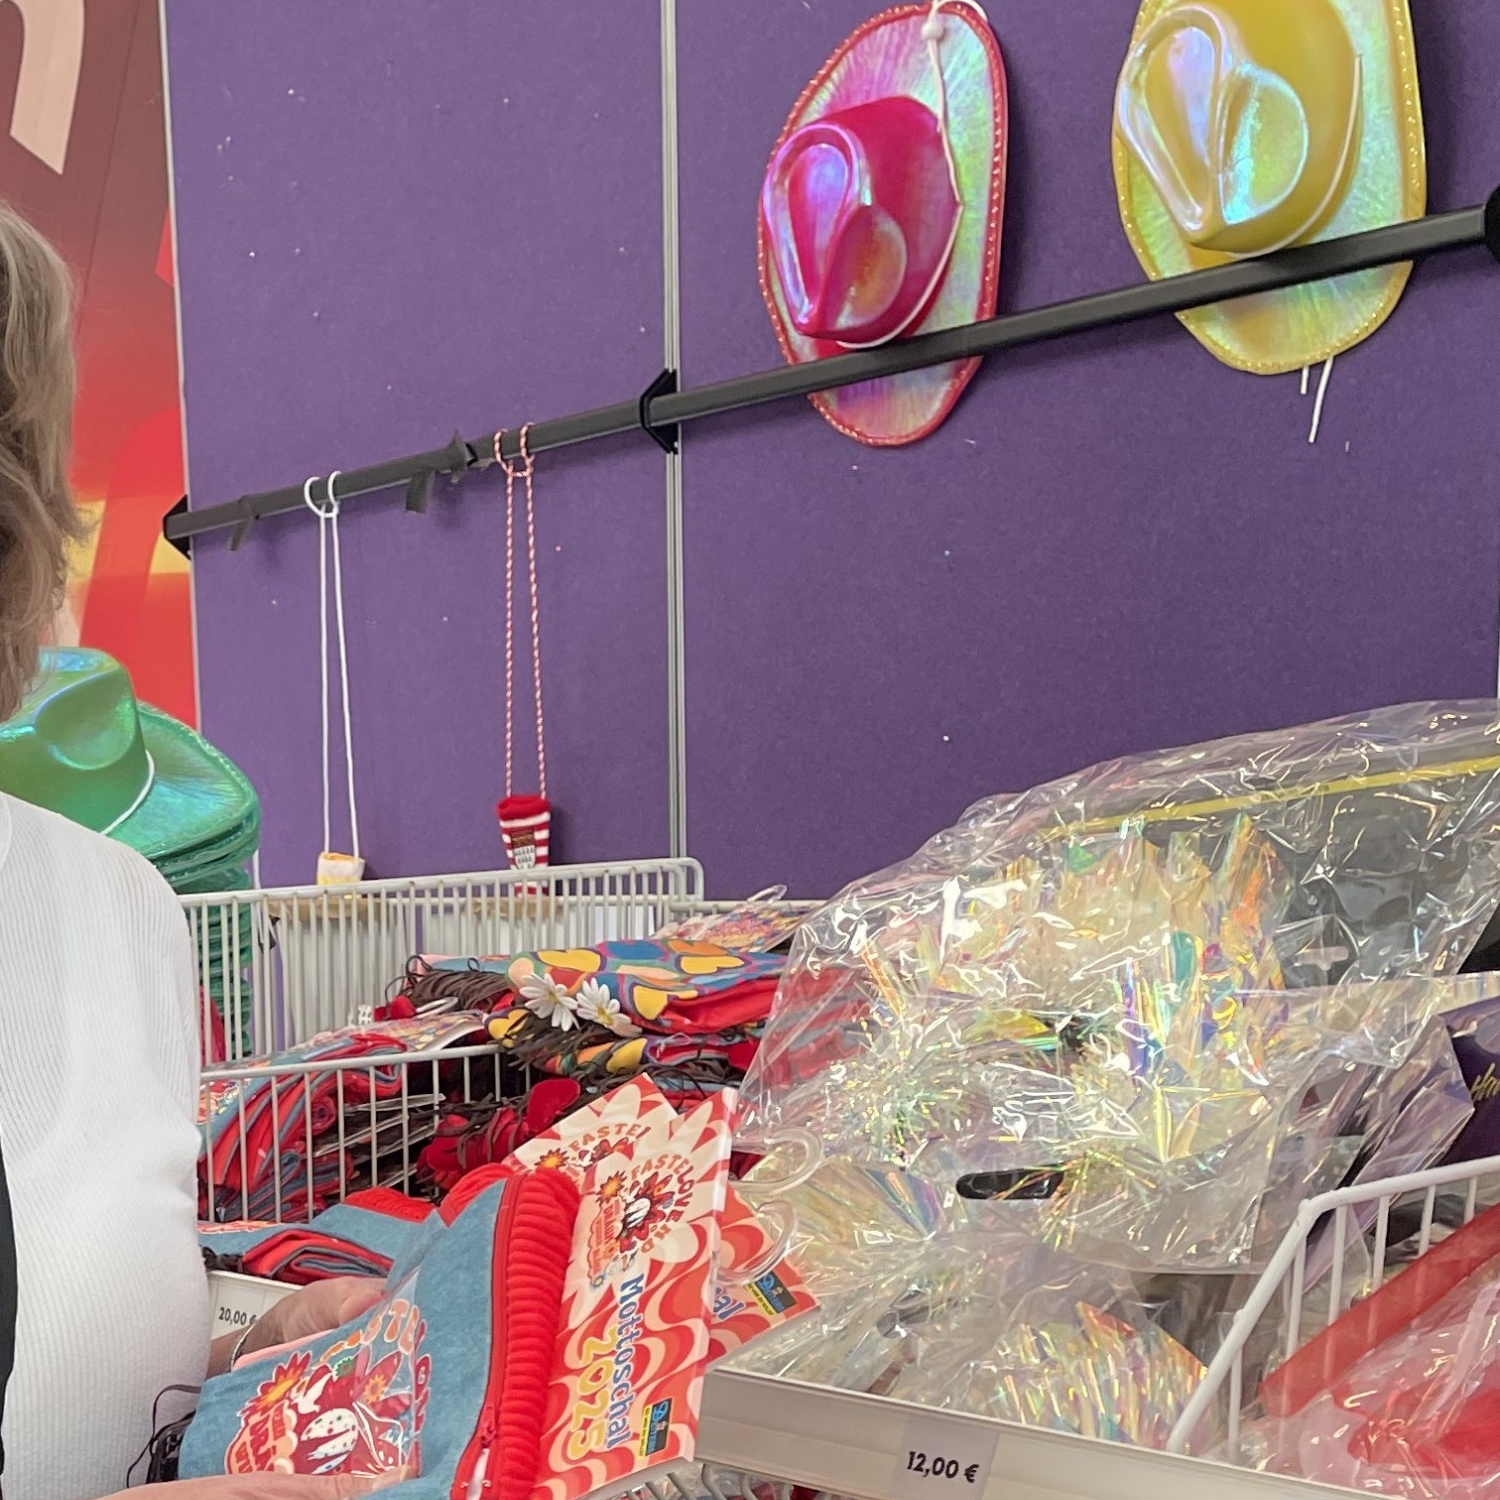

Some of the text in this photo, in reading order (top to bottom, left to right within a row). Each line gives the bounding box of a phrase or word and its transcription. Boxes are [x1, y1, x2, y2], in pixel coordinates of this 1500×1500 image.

[218, 1306, 247, 1326] 20,00
[566, 1326, 619, 1460] 2025
[605, 1273, 645, 1449] Mottoschal
[907, 1450, 979, 1483] 12,00 €
